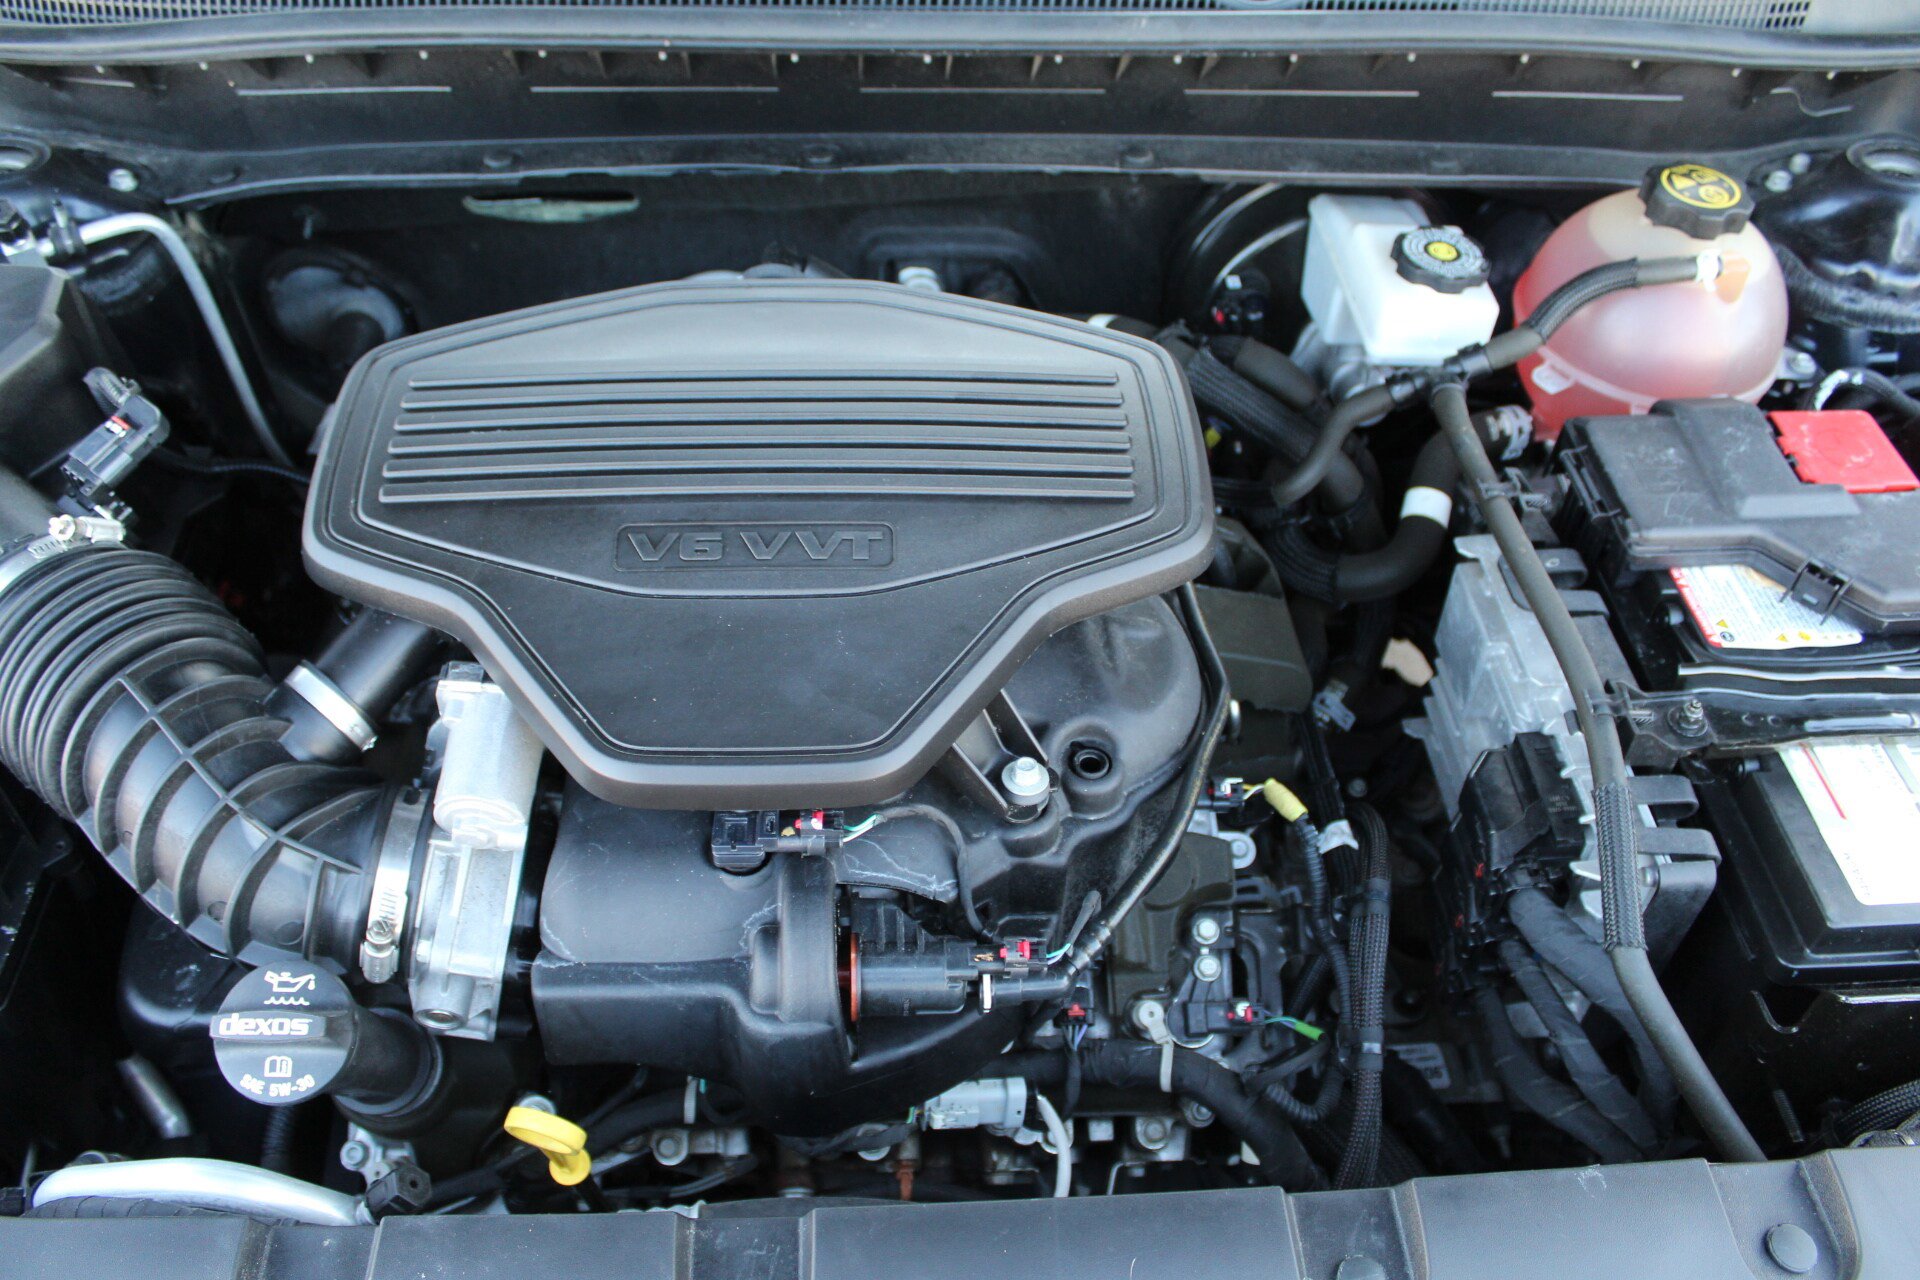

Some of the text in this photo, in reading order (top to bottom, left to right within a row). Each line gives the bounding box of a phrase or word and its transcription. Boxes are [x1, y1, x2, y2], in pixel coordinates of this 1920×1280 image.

[627, 531, 883, 561] V6 VVT
[218, 1013, 310, 1036] dexos
[240, 1074, 316, 1097] SAE 5W-30
